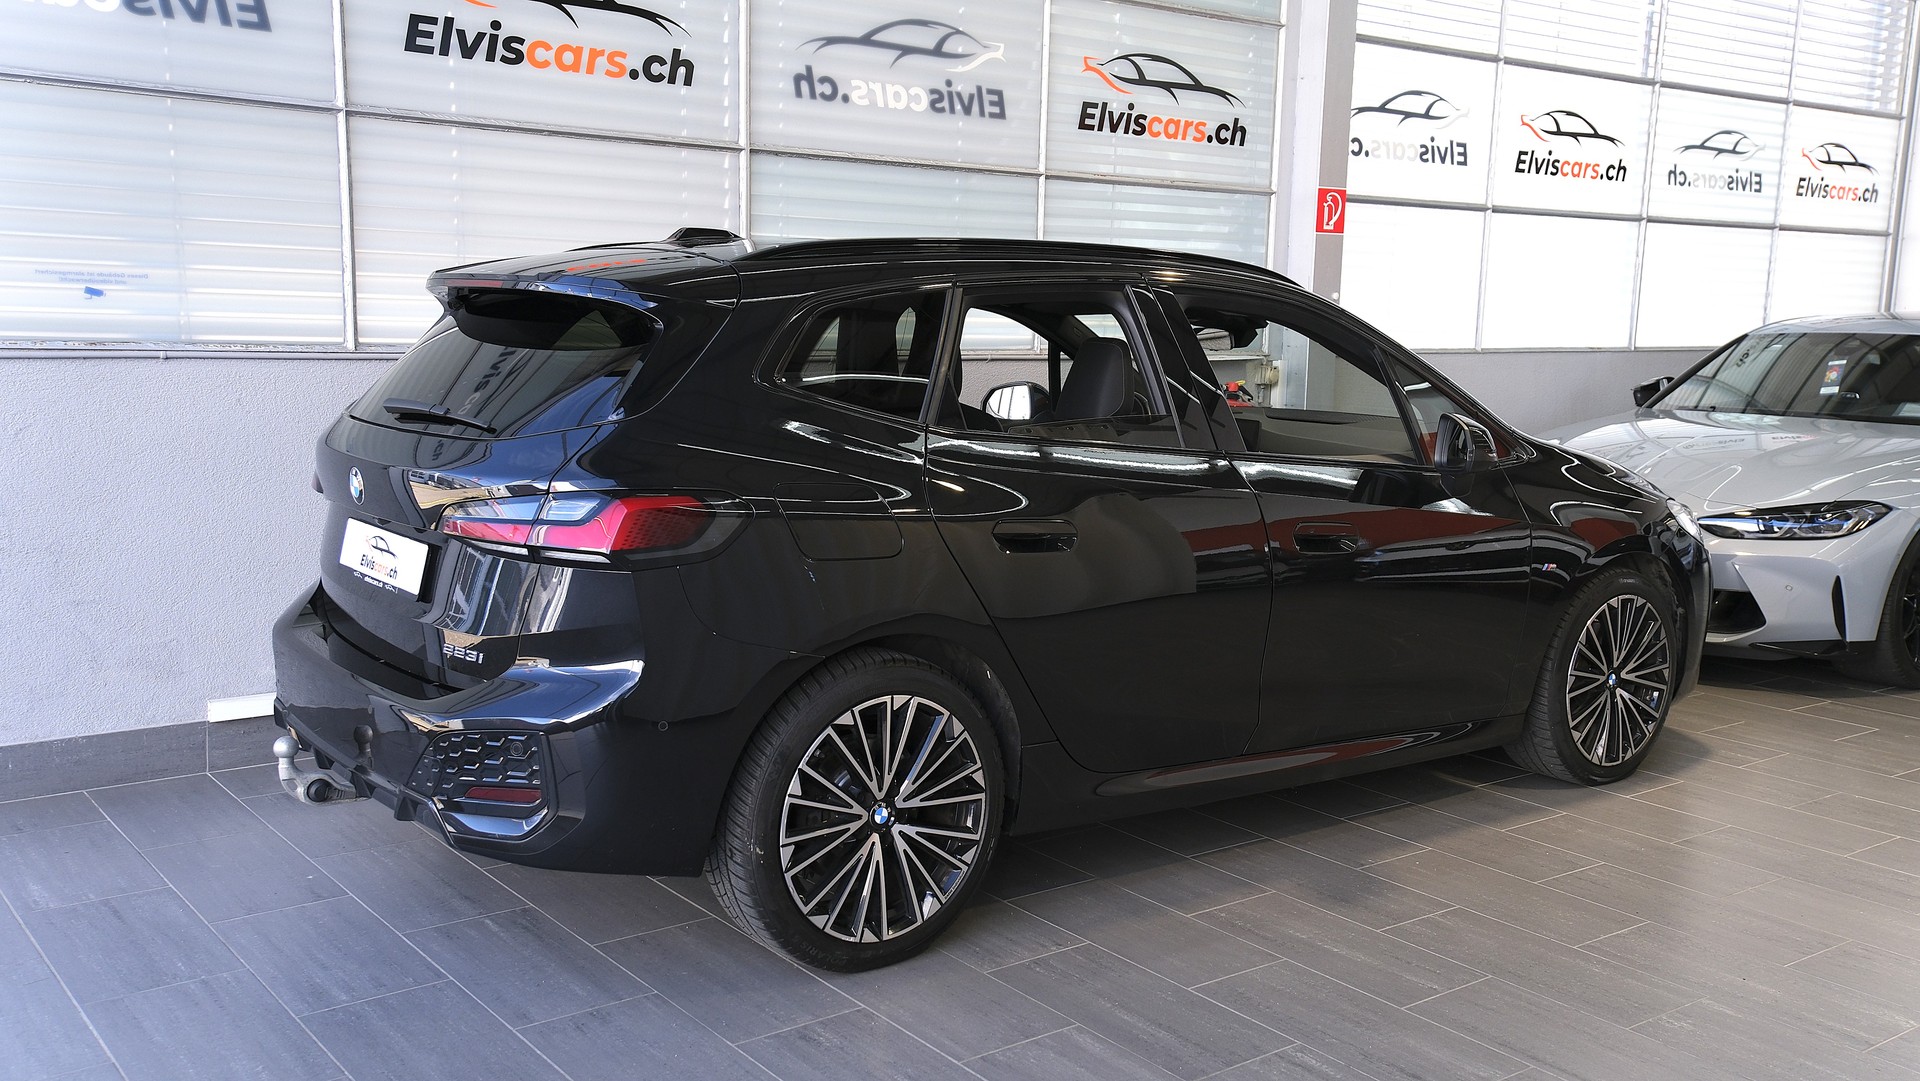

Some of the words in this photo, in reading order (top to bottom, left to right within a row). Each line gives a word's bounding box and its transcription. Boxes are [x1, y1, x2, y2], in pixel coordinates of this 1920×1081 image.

[403, 13, 695, 87] Elviscars.ch
[1078, 101, 1247, 147] Elviscars.ch
[1514, 150, 1627, 182] Elviscars.ch
[1796, 177, 1879, 203] Elviscars.ch
[360, 554, 398, 580] Elviscars.ch
[442, 643, 484, 665] 223i
